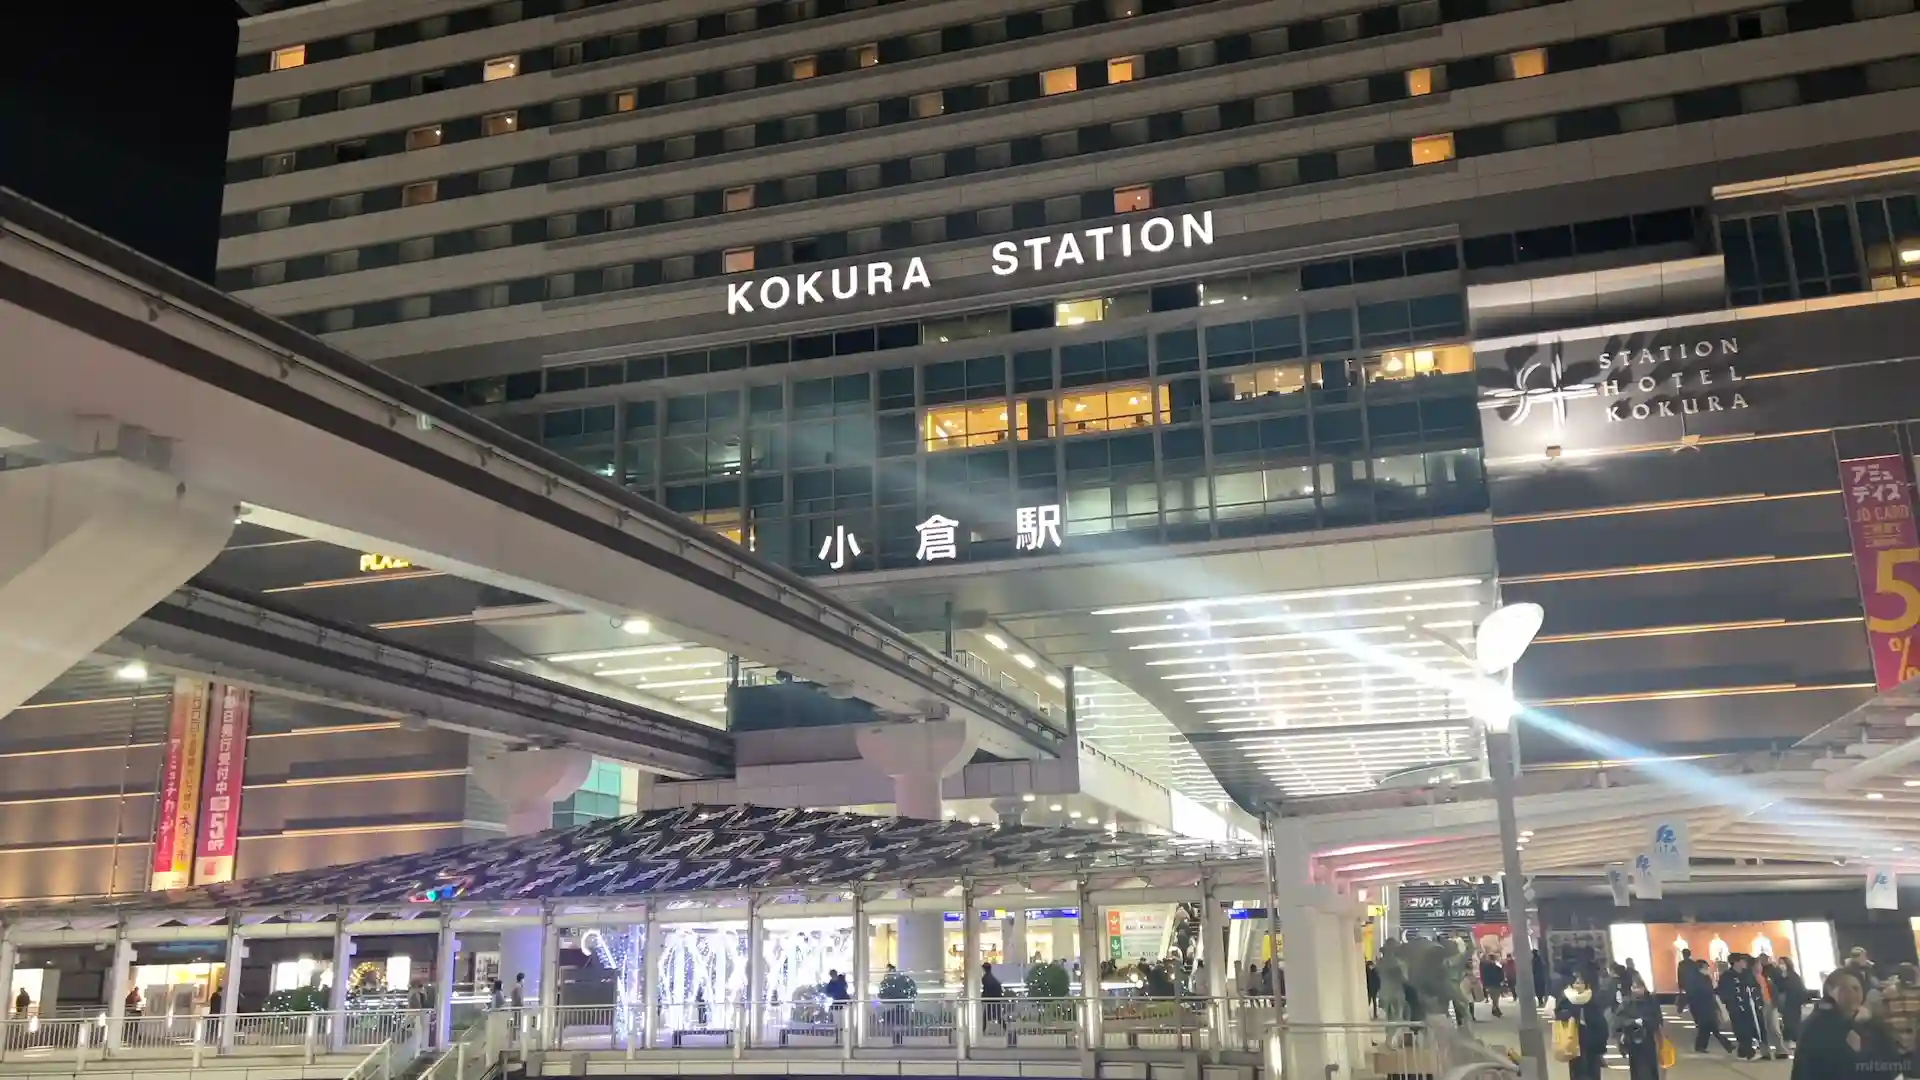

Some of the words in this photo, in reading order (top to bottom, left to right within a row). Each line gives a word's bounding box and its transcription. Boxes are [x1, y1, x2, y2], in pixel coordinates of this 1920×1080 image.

[727, 256, 931, 315] KOKURA
[992, 210, 1214, 275] STATION
[1599, 337, 1739, 369] STATION
[1602, 365, 1742, 396] HOTEL
[1605, 393, 1749, 422] KOKURA
[818, 504, 1062, 569] 小倉駅
